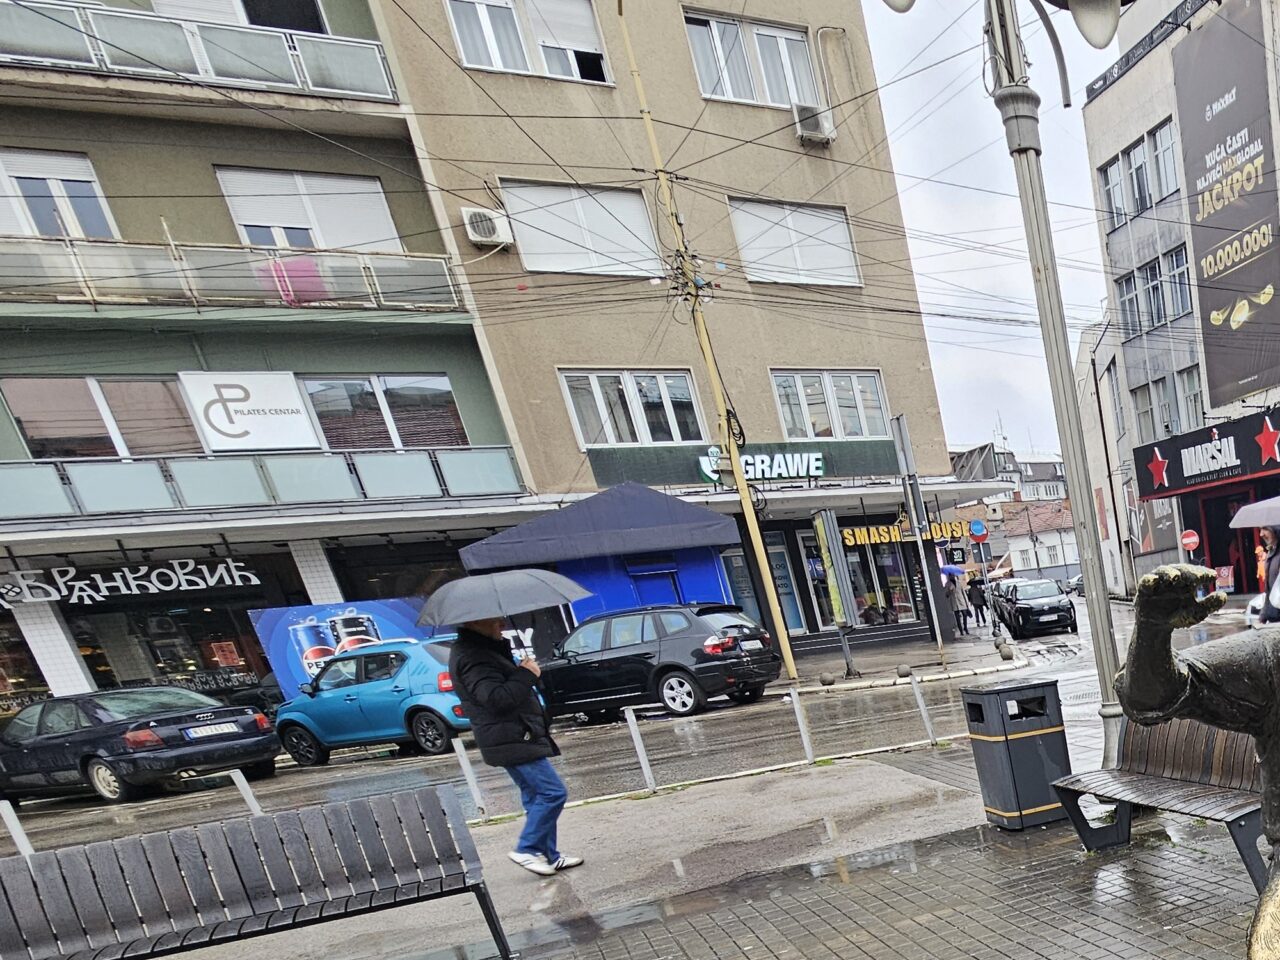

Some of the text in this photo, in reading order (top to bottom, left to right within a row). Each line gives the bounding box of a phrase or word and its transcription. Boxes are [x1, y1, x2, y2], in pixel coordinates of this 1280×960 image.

[1195, 153, 1265, 222] JACKPOT
[1200, 223, 1273, 278] 10.000.000!
[233, 408, 302, 416] PILATES CENTAR
[740, 453, 823, 480] GRAWE
[843, 525, 901, 546] SMASH
[9, 558, 261, 605] БРАНКОВИЋ
